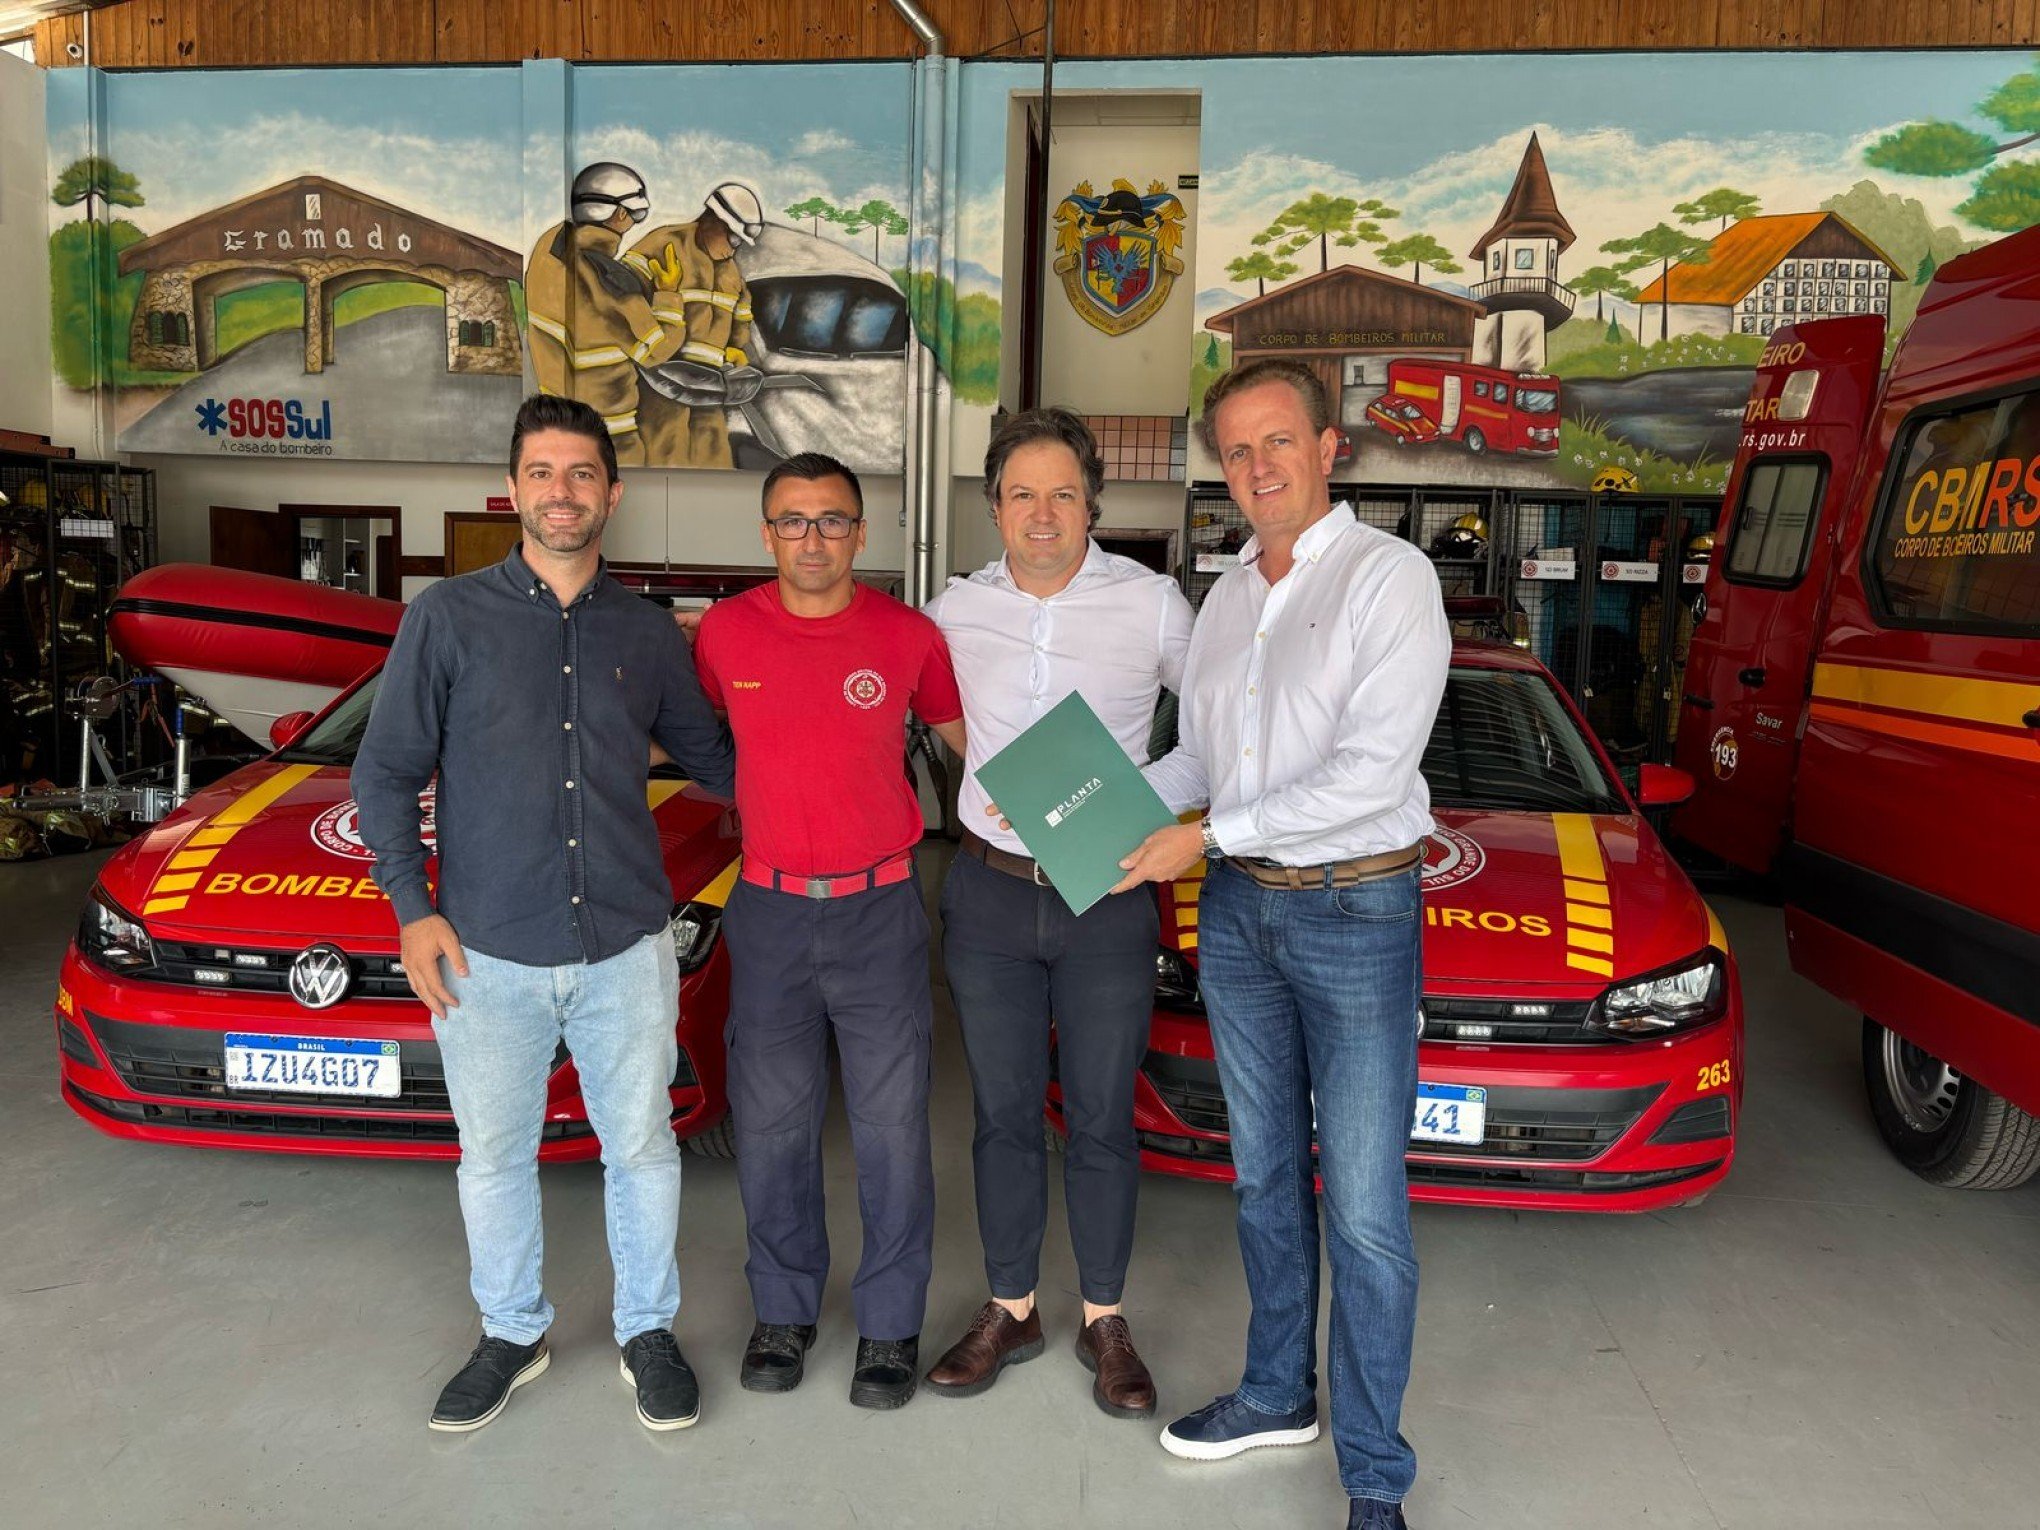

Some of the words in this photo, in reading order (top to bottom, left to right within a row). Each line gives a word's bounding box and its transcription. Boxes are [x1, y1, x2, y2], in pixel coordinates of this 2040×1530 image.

[224, 223, 412, 253] Gramado
[1304, 333, 1319, 345] DE
[1329, 332, 1395, 344] BOMBEIROS
[1402, 332, 1446, 343] MILITAR
[219, 440, 227, 451] A
[230, 442, 259, 453] casa
[261, 441, 277, 454] do
[279, 442, 333, 456] bombeiro
[1894, 538, 1928, 558] CORPO
[1927, 537, 1943, 557] DE
[1988, 530, 2035, 555] MILITAR
[1756, 712, 1783, 729] Savar
[1715, 743, 1736, 769] 193
[1057, 778, 1101, 813] PLANTA
[203, 872, 390, 900] BOMBE
[1426, 906, 1552, 937] IROS
[297, 1042, 325, 1051] BRASIL
[229, 1075, 239, 1085] BR
[242, 1051, 380, 1088] IZU4G07
[1696, 1059, 1730, 1091] 263
[1413, 1103, 1461, 1134] 41
